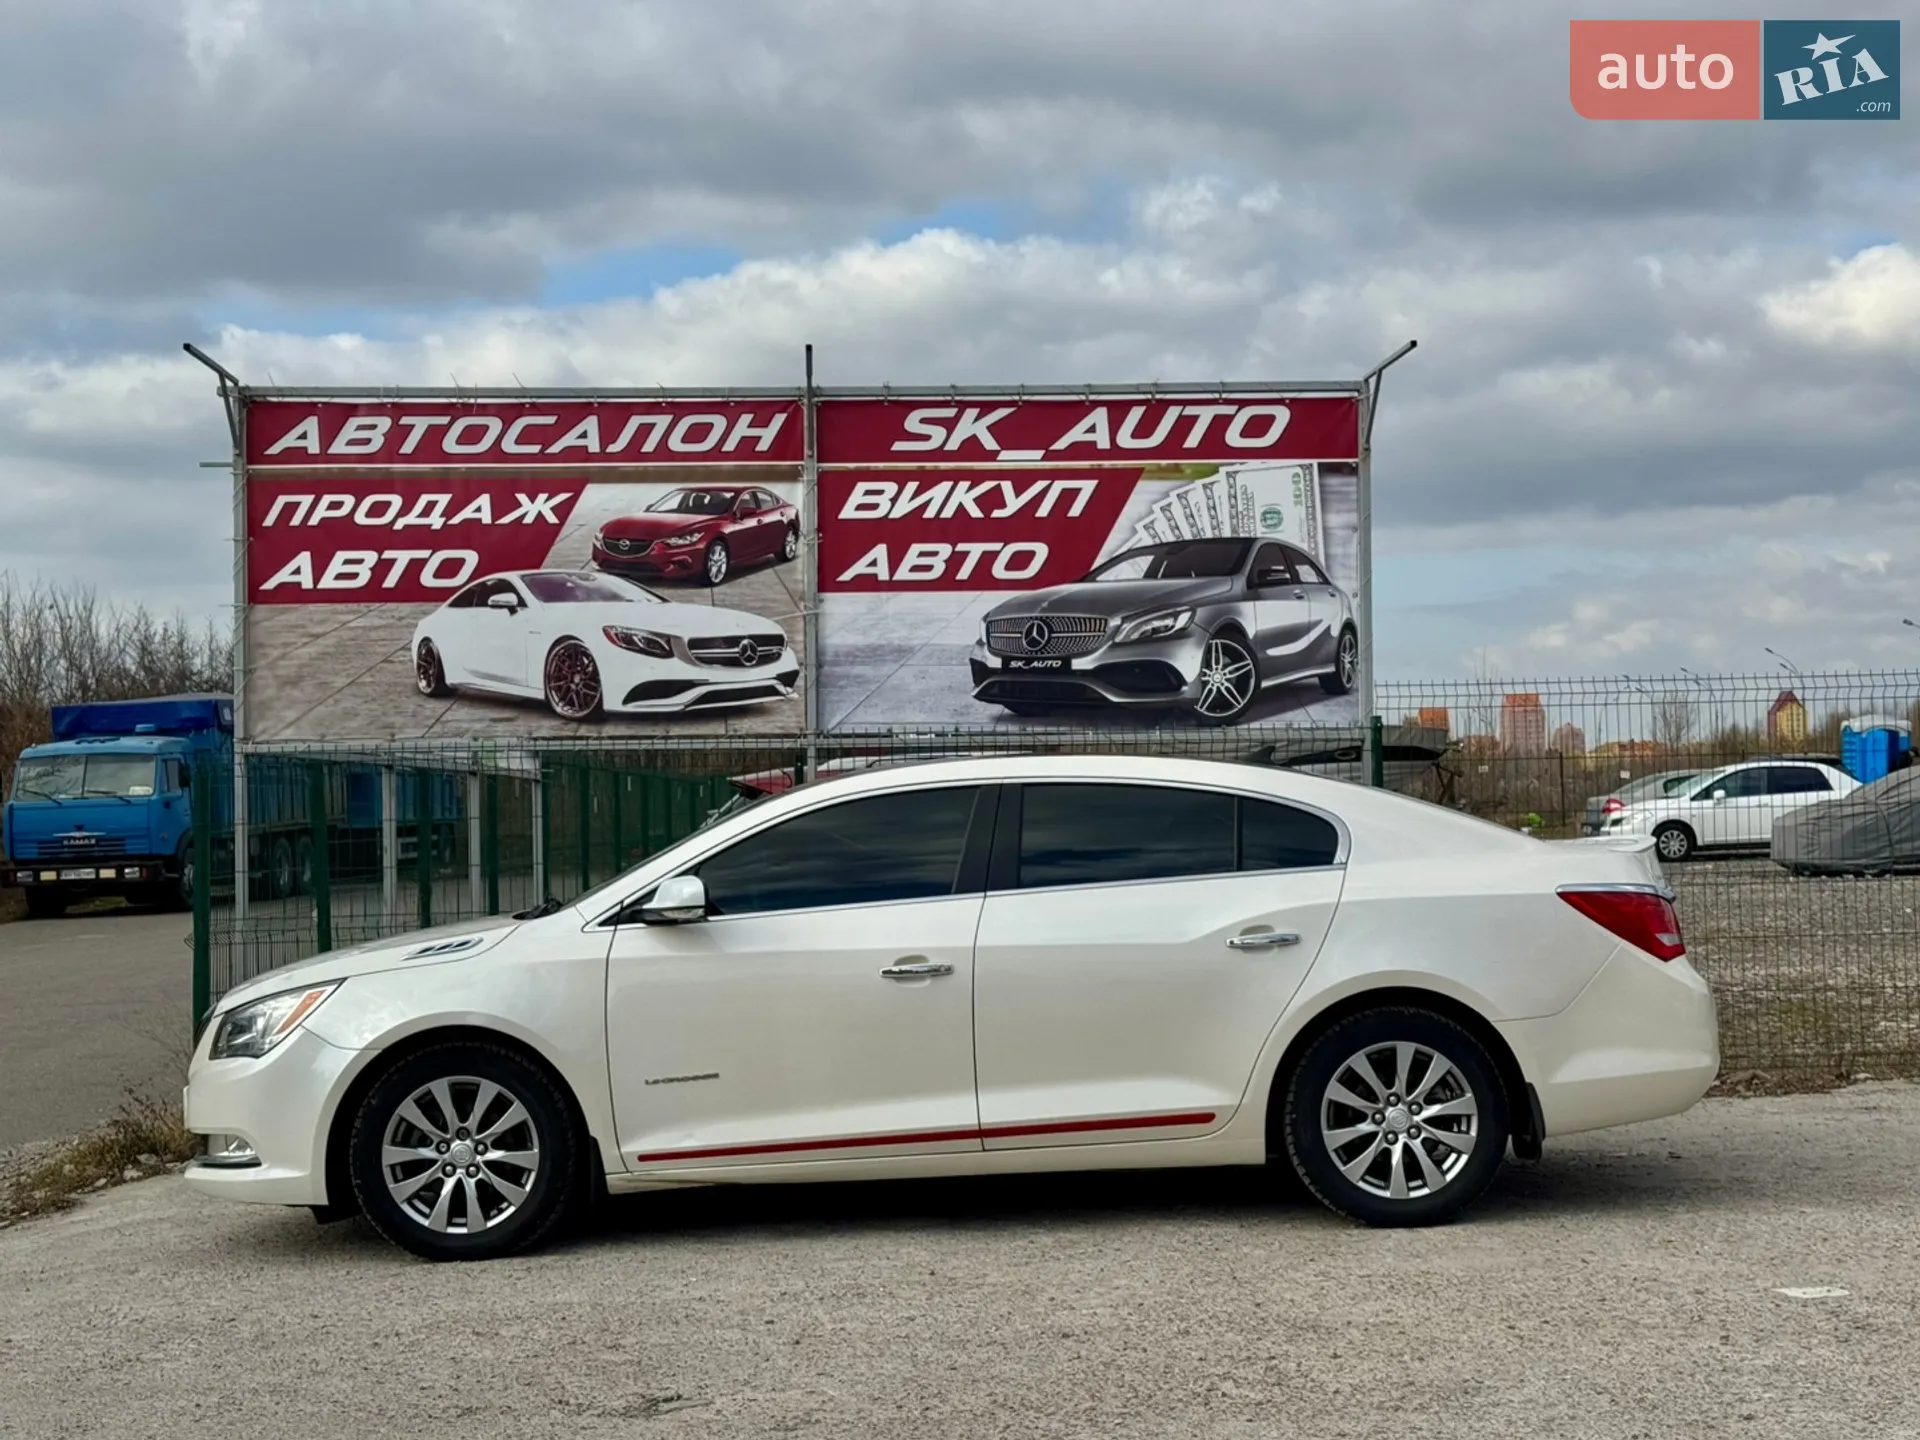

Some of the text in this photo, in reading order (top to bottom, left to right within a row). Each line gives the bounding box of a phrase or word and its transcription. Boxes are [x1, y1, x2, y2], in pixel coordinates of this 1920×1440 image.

[264, 412, 789, 456] АВТОСАЛОН
[891, 404, 1292, 461] SK_AUTO
[262, 492, 576, 531] ПРОДАЖ
[838, 479, 1099, 520] ВИКУП
[259, 549, 480, 590] АВТО
[836, 541, 1050, 582] АВТО
[1009, 660, 1062, 669] SK_AUTO
